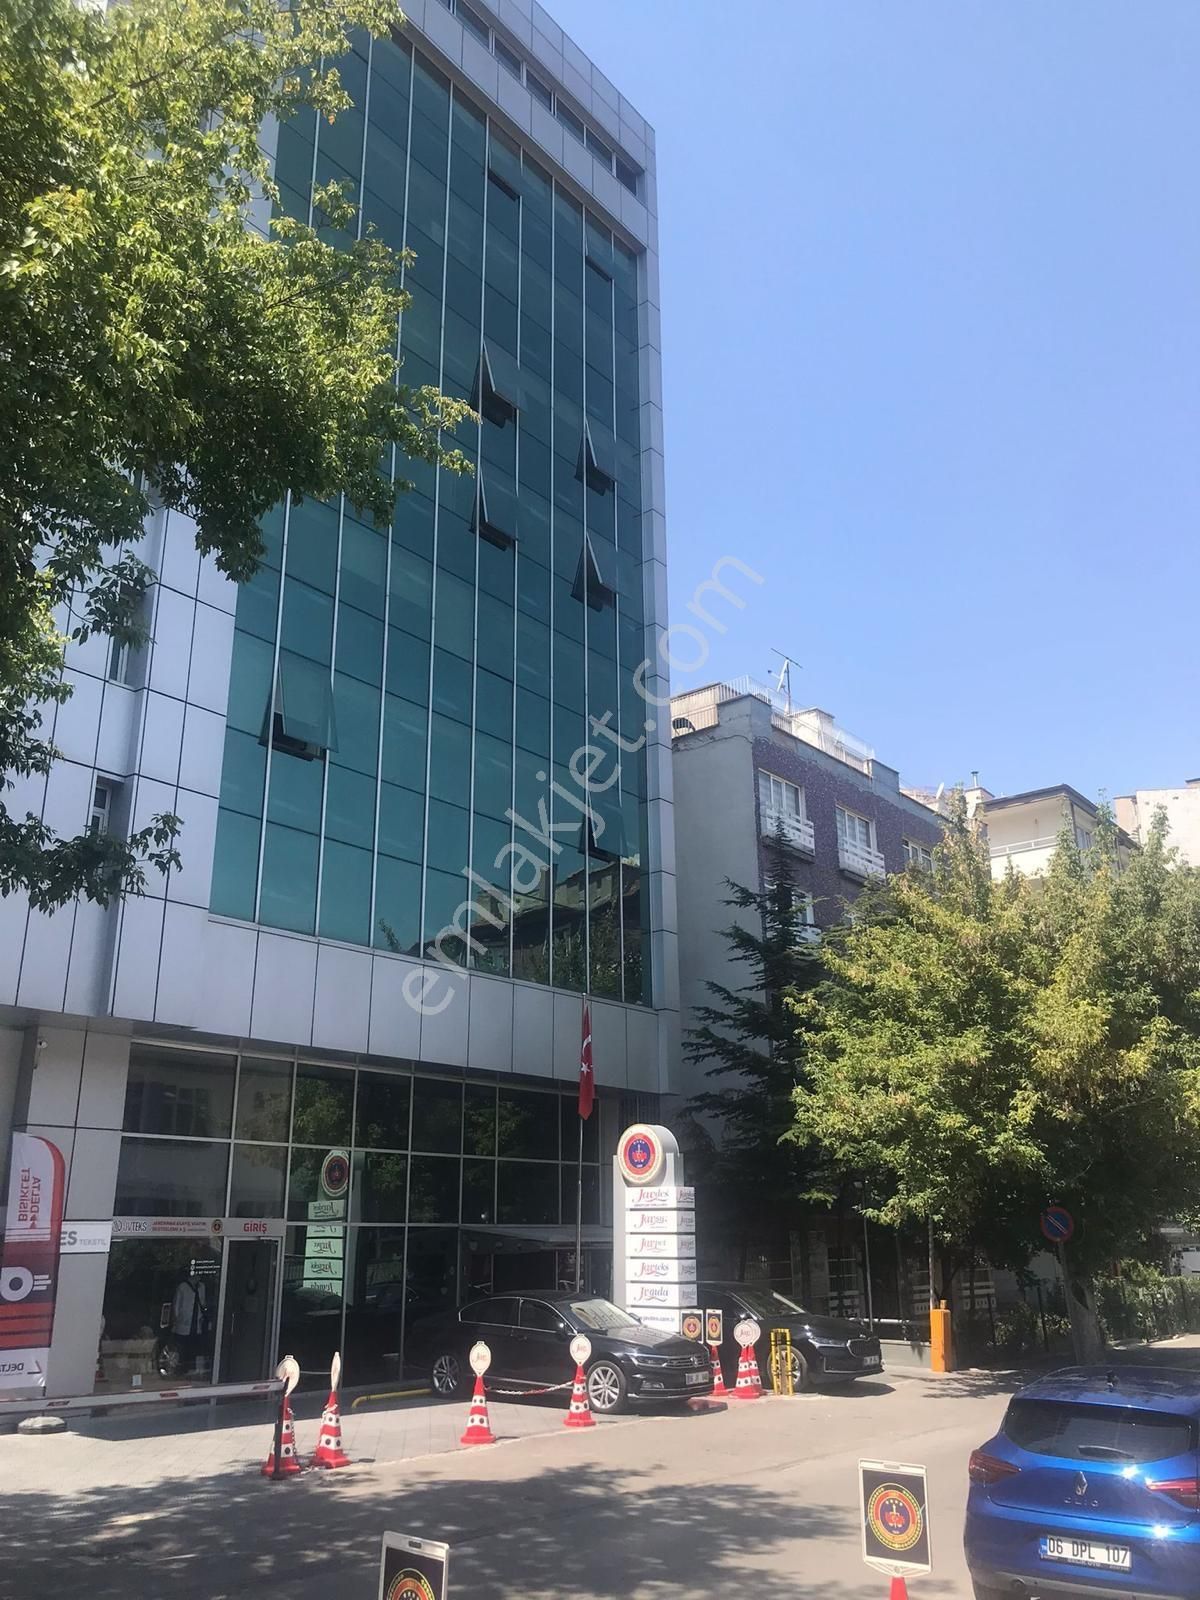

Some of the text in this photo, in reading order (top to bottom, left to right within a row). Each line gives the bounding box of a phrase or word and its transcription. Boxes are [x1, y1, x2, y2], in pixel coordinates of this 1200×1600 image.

[243, 1220, 268, 1234] GİRİŞ
[1048, 1537, 1063, 1555] 06
[1072, 1540, 1095, 1560] DPL
[1105, 1545, 1128, 1564] 107
